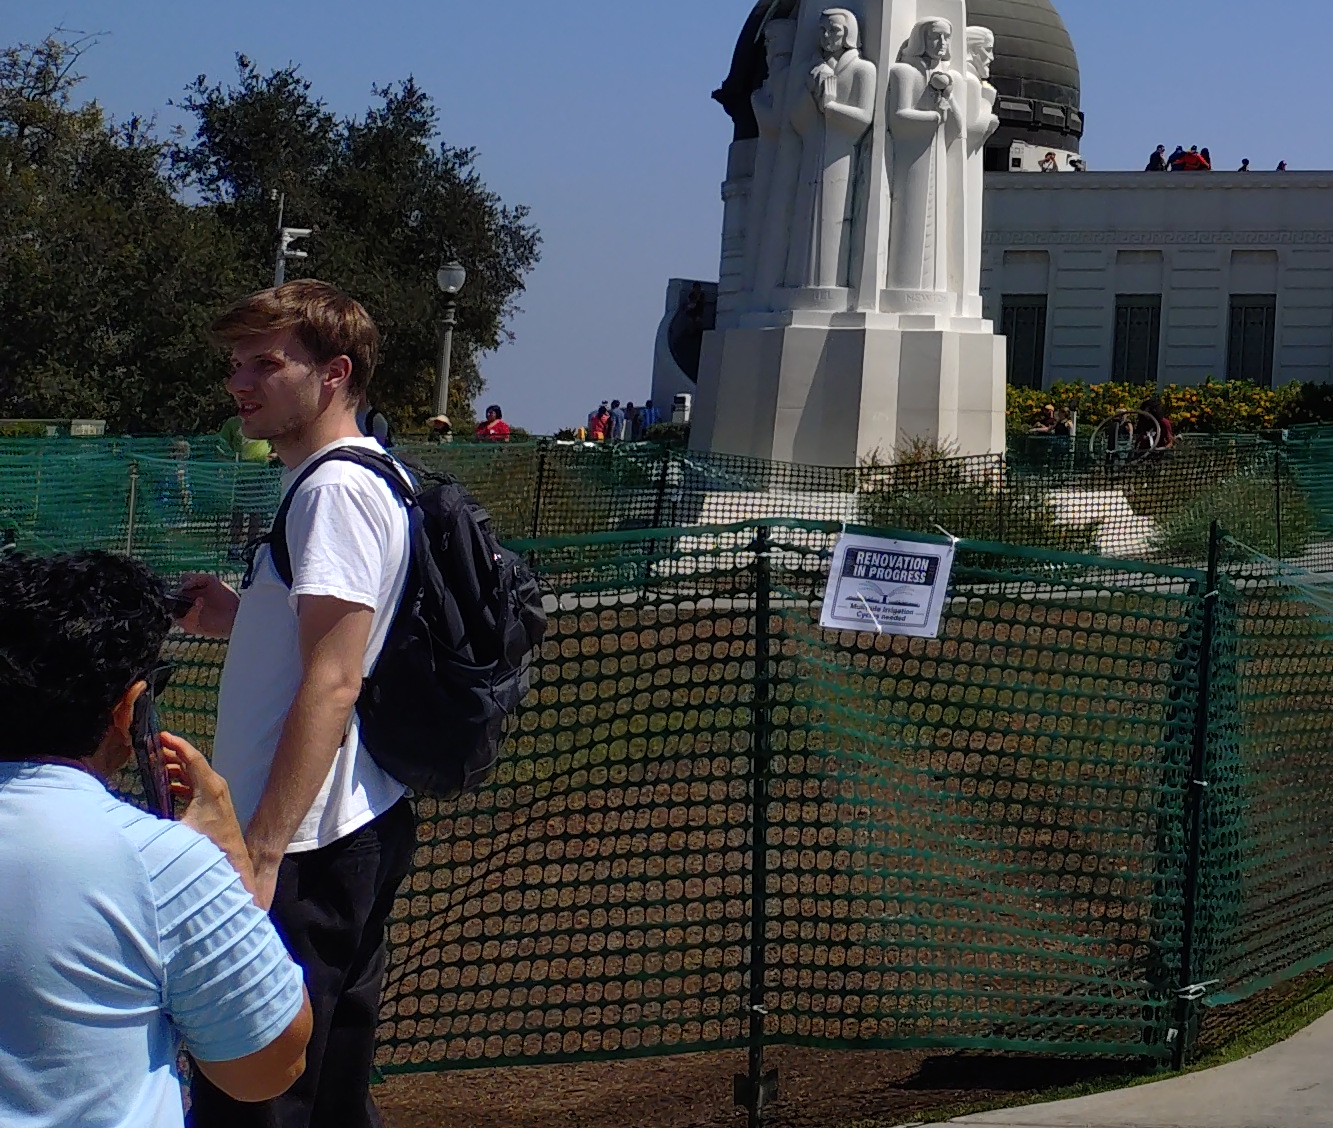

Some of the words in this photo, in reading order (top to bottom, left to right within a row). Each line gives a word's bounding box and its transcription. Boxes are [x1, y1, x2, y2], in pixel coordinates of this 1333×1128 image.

[856, 551, 929, 571] RENOVATION
[853, 564, 866, 576] IN
[868, 566, 926, 583] PROGRESS
